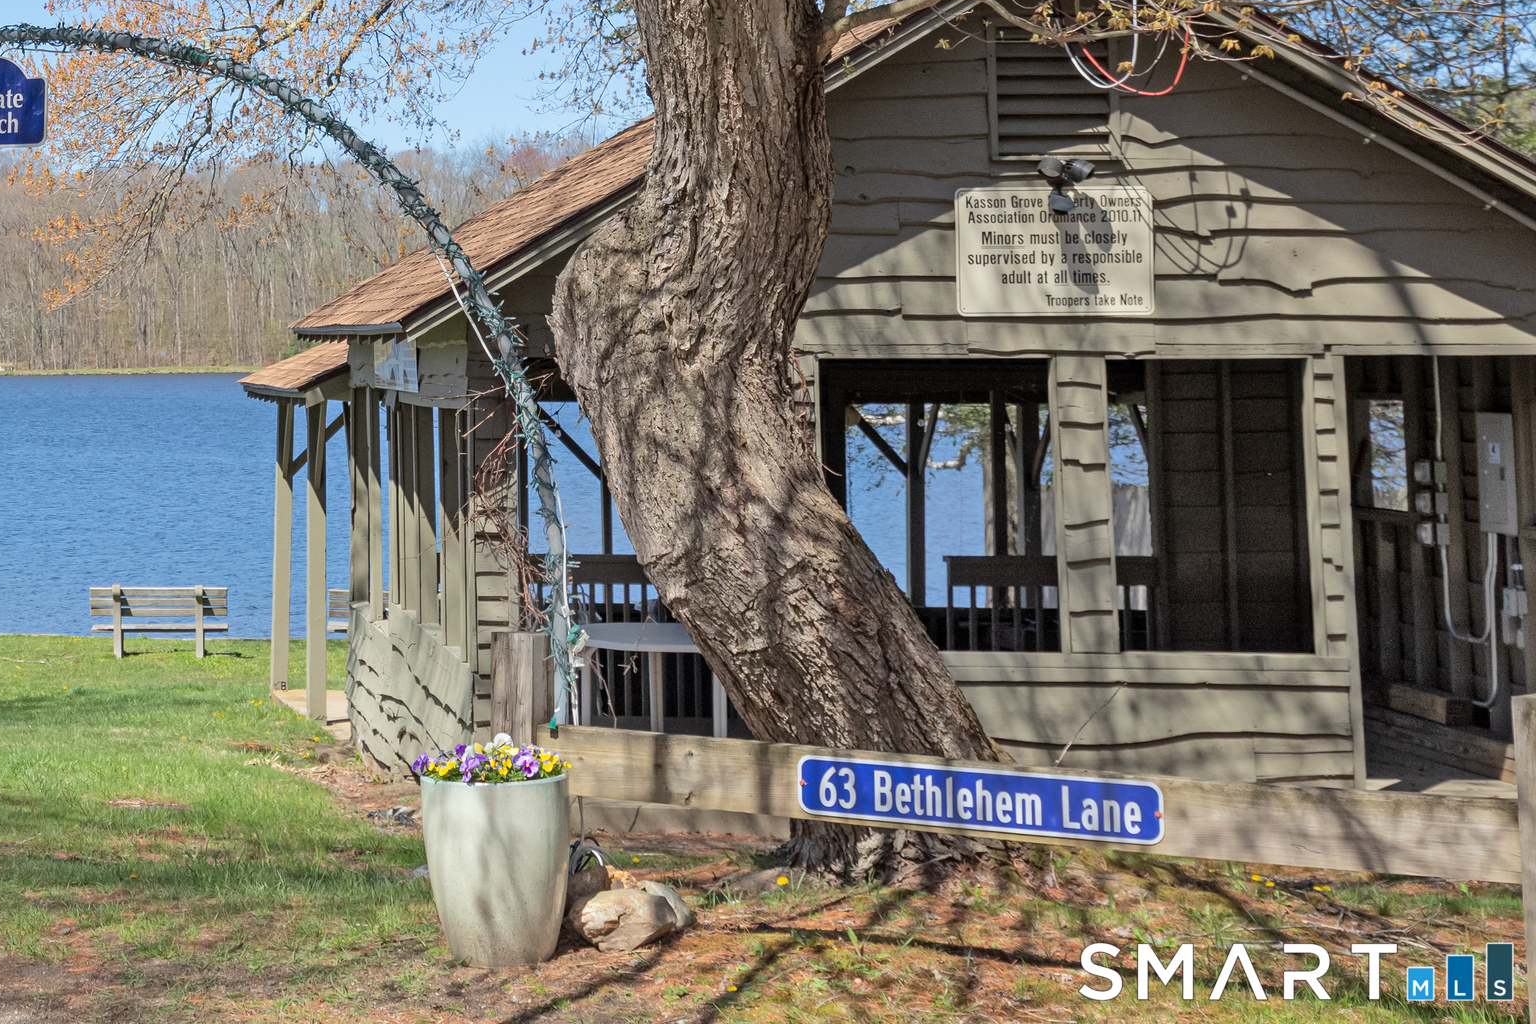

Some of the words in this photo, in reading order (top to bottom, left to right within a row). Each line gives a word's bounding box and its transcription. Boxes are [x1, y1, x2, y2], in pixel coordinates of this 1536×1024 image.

[965, 195, 1007, 209] Kasson
[1011, 195, 1043, 209] Grove
[1100, 194, 1142, 208] Owners
[967, 210, 1035, 224] Association
[1101, 209, 1142, 223] 2010.11
[981, 231, 1024, 246] Minors
[1030, 231, 1060, 245] must
[1065, 231, 1080, 245] be
[1084, 230, 1128, 246] closely
[967, 251, 1036, 267] supervised
[1041, 250, 1056, 267] by
[1060, 253, 1068, 264] a
[1072, 249, 1143, 266] responsible
[1001, 270, 1032, 285] adult
[1037, 271, 1049, 284] at
[1054, 270, 1068, 285] all
[1073, 270, 1111, 285] times.
[1046, 295, 1090, 308] Troopers
[1094, 294, 1116, 307] take
[1120, 293, 1144, 306] Note
[818, 766, 857, 810] 63
[873, 770, 1043, 827] Bethlehem
[1061, 785, 1142, 835] Lane
